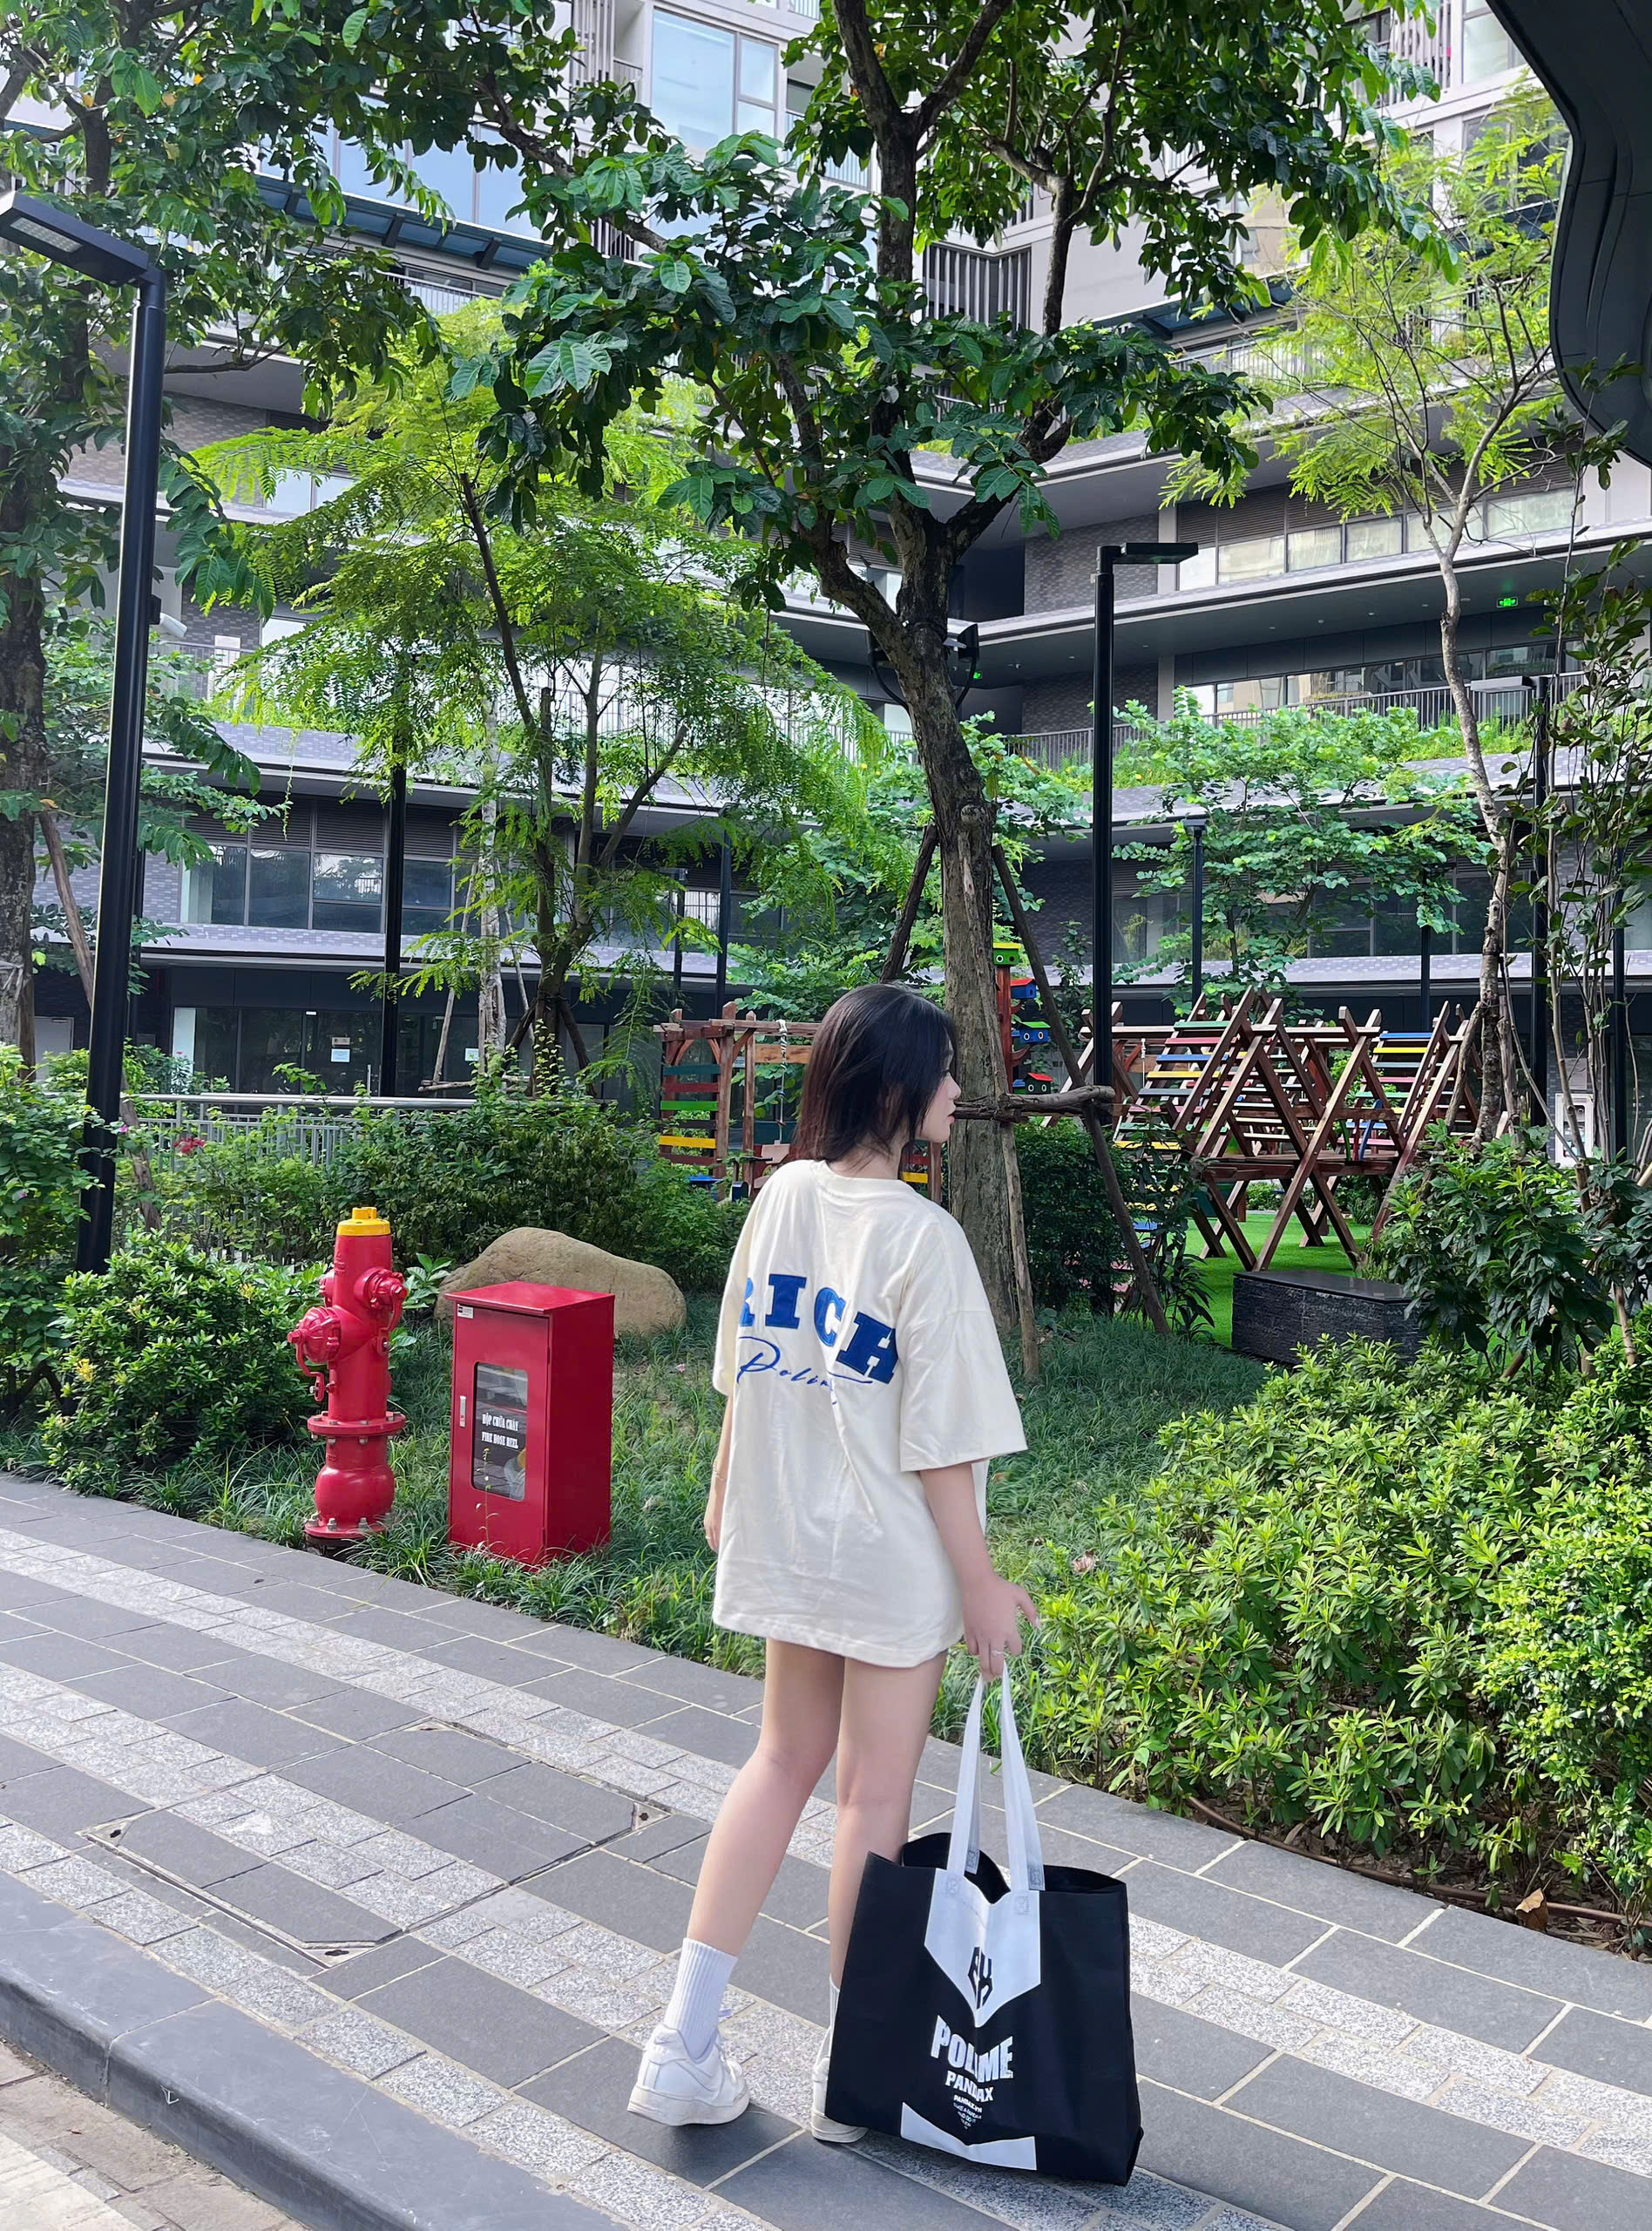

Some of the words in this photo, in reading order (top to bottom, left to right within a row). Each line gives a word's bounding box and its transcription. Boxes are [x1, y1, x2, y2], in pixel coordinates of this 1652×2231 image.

[482, 1432, 493, 1443] FIRE
[493, 1434, 505, 1446] HOSE
[506, 1437, 518, 1449] REEL
